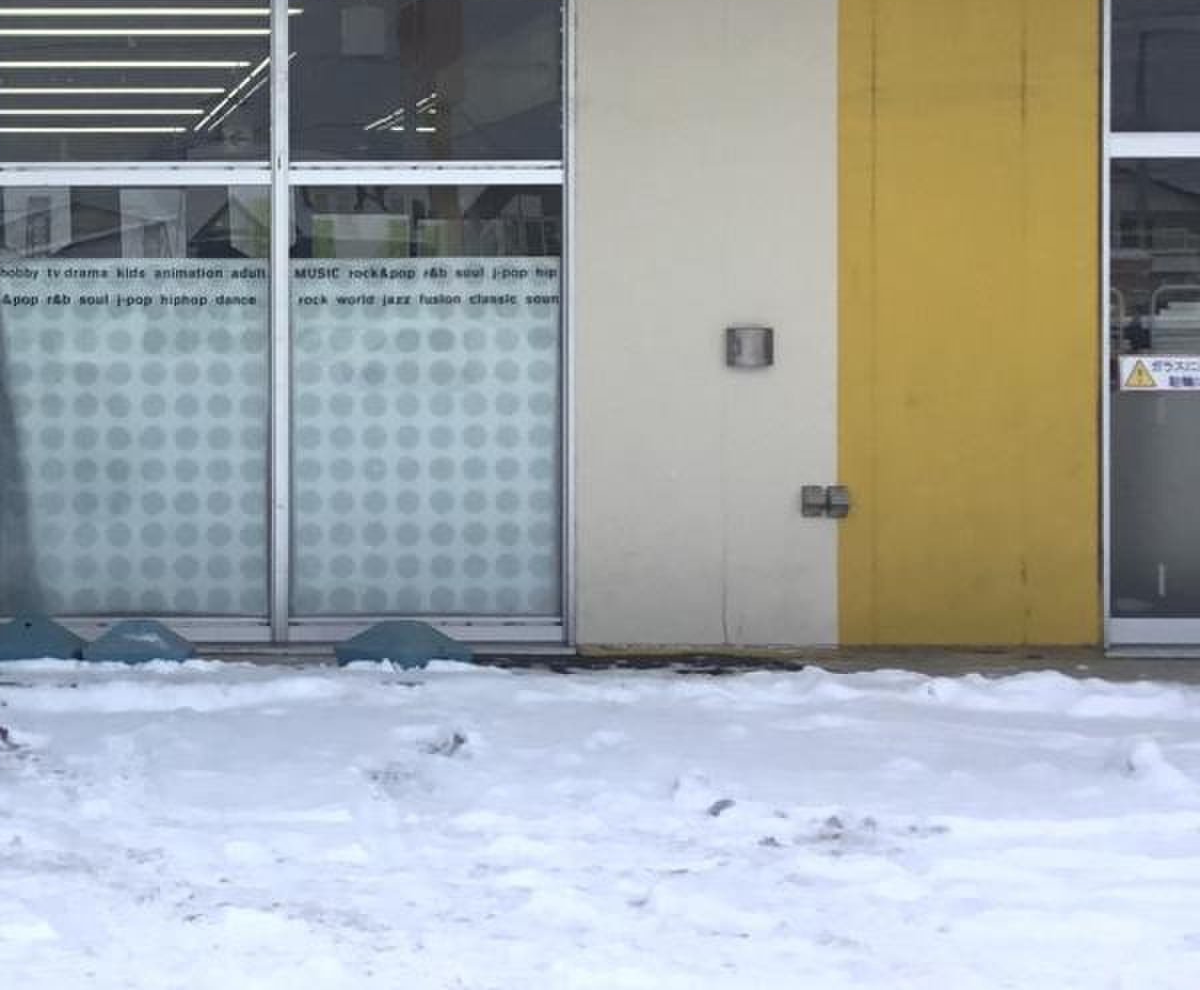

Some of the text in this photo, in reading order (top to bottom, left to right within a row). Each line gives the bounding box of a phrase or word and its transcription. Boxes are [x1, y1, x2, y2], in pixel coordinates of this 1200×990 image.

[47, 267, 62, 280] tv
[64, 267, 108, 280] drama
[117, 267, 146, 280] kids
[154, 266, 224, 280] animation
[231, 266, 267, 280] adult
[294, 266, 340, 280] MUSIC
[349, 266, 416, 283] rock&pop
[423, 266, 448, 279] r&b
[455, 266, 485, 279] soul
[492, 266, 529, 282] j-pop
[46, 293, 71, 307] r&b
[79, 294, 109, 307] soul
[117, 293, 153, 309] j-pop
[160, 293, 208, 308] hiphop
[215, 294, 257, 307] dance
[299, 293, 329, 306] rock
[336, 293, 376, 306] world
[382, 293, 411, 308] jazz
[419, 293, 462, 306] fusion
[469, 293, 518, 306] classic
